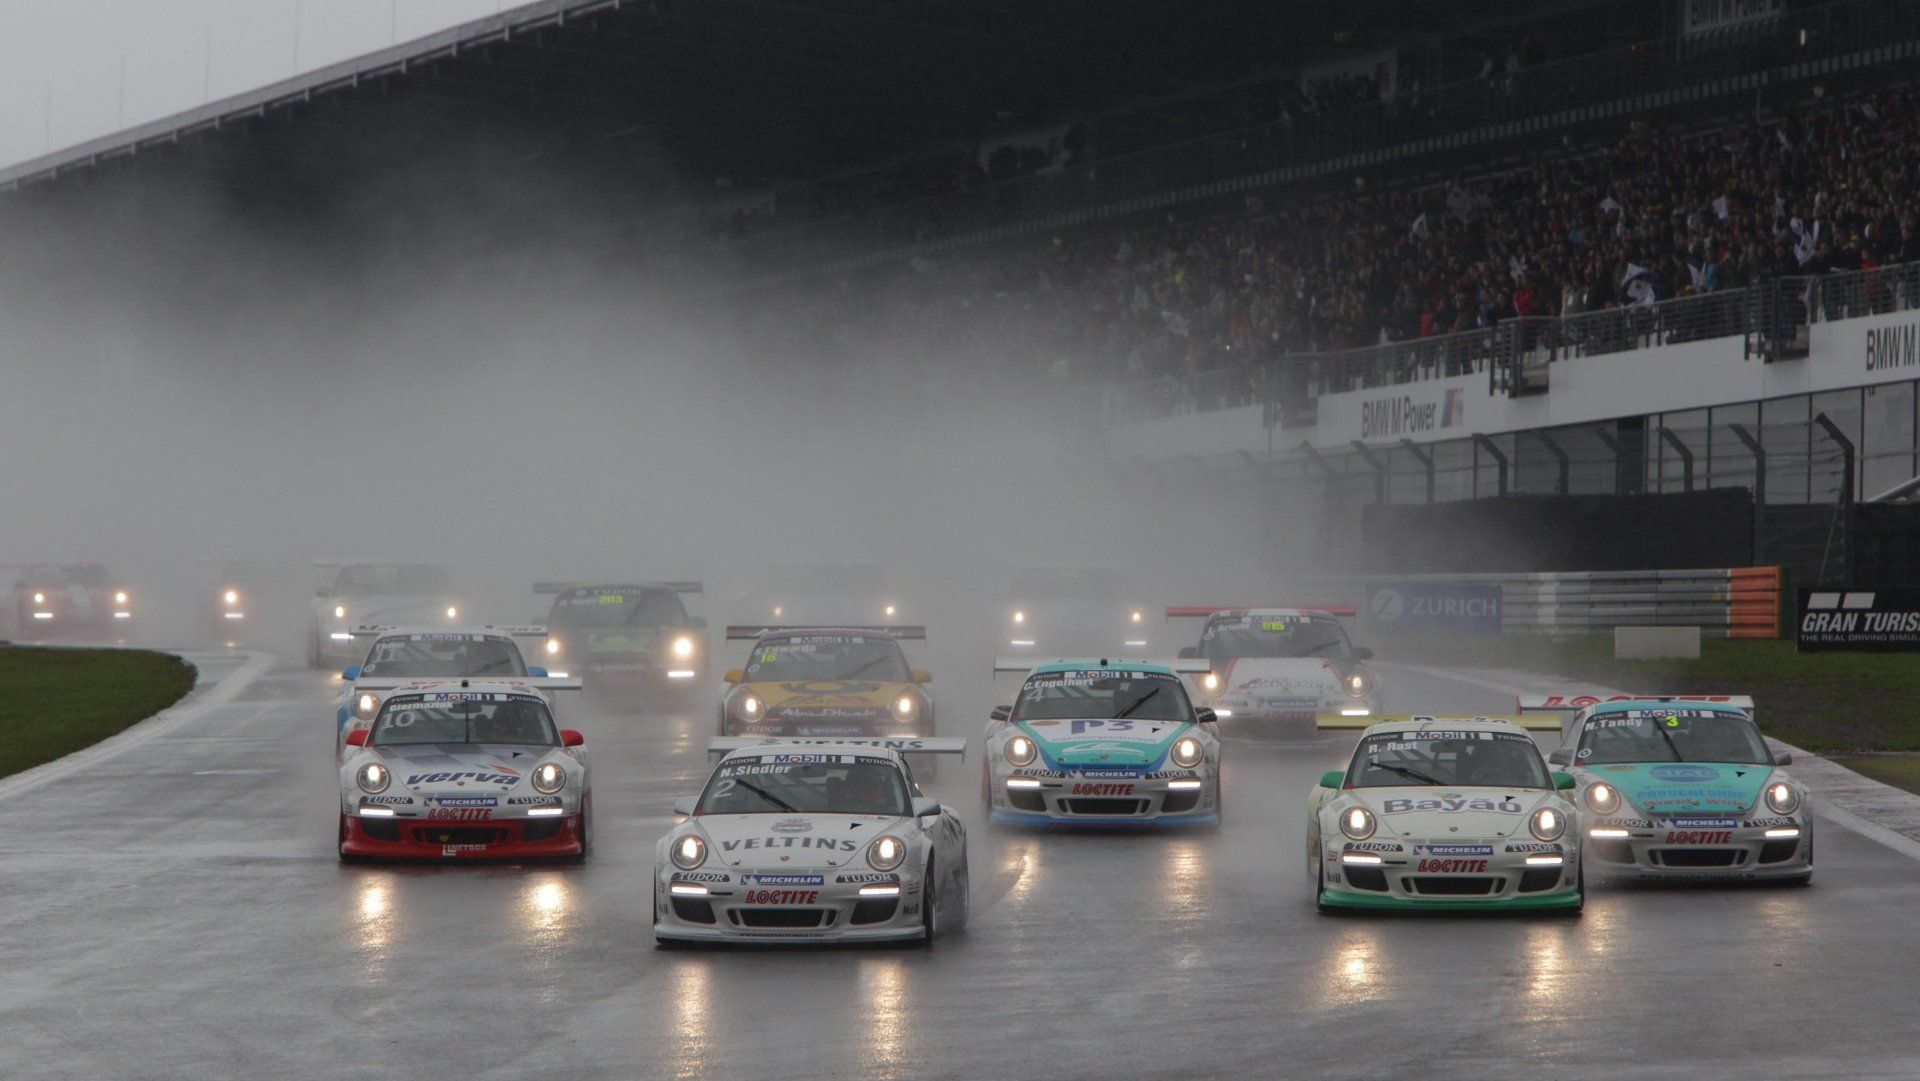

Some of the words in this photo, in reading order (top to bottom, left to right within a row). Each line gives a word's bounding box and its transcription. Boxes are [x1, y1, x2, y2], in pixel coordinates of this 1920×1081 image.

[1866, 326, 1902, 371] BMW
[1904, 323, 1915, 366] M
[1362, 399, 1390, 438] BMW
[1392, 397, 1401, 434] M
[1403, 396, 1436, 433] Power
[598, 595, 623, 604] 203
[1411, 598, 1497, 616] ZURICH
[1262, 622, 1285, 632] 815
[1802, 612, 1858, 632] GRAN
[1864, 612, 1920, 632] TURIS
[760, 653, 776, 663] 16
[1024, 679, 1094, 690] C.Engelhart
[436, 693, 478, 701] Mobil
[1025, 690, 1046, 702] 4
[389, 702, 454, 712] Giermaziak
[382, 711, 416, 729] 10
[1585, 718, 1642, 731] N.Tandy
[1666, 716, 1678, 728] 3
[1071, 720, 1134, 734] P3
[1416, 732, 1461, 740] Mobil
[1369, 744, 1382, 753] R.
[1387, 742, 1417, 751] Rast
[725, 757, 758, 766] TUDOR
[774, 754, 822, 764] Mobil
[720, 764, 792, 778] N.Siedler
[1020, 770, 1062, 778] TUDOR
[1150, 770, 1191, 778] TUDOR
[406, 772, 522, 786] verva
[712, 779, 737, 799] 2
[1072, 784, 1134, 796] LOCTITE
[365, 796, 410, 804] TUDOR
[441, 798, 496, 806] MICHELIN
[512, 796, 556, 804] TUDOR
[1384, 798, 1522, 814] Bayão
[428, 808, 492, 820] LOCTITE
[1602, 818, 1649, 828] TUDOR
[1747, 817, 1790, 827] TUDOR
[1666, 831, 1732, 844] LOCTITE
[722, 837, 859, 851] VELTINS
[1350, 843, 1399, 851] TUDOR
[1508, 844, 1555, 852] TUDOR
[1417, 860, 1488, 872] LOCTITE
[678, 872, 727, 882] TUDOR
[759, 876, 822, 884] MICHELIN
[840, 873, 892, 882] TUDOR
[746, 890, 818, 904] LOCTITE
